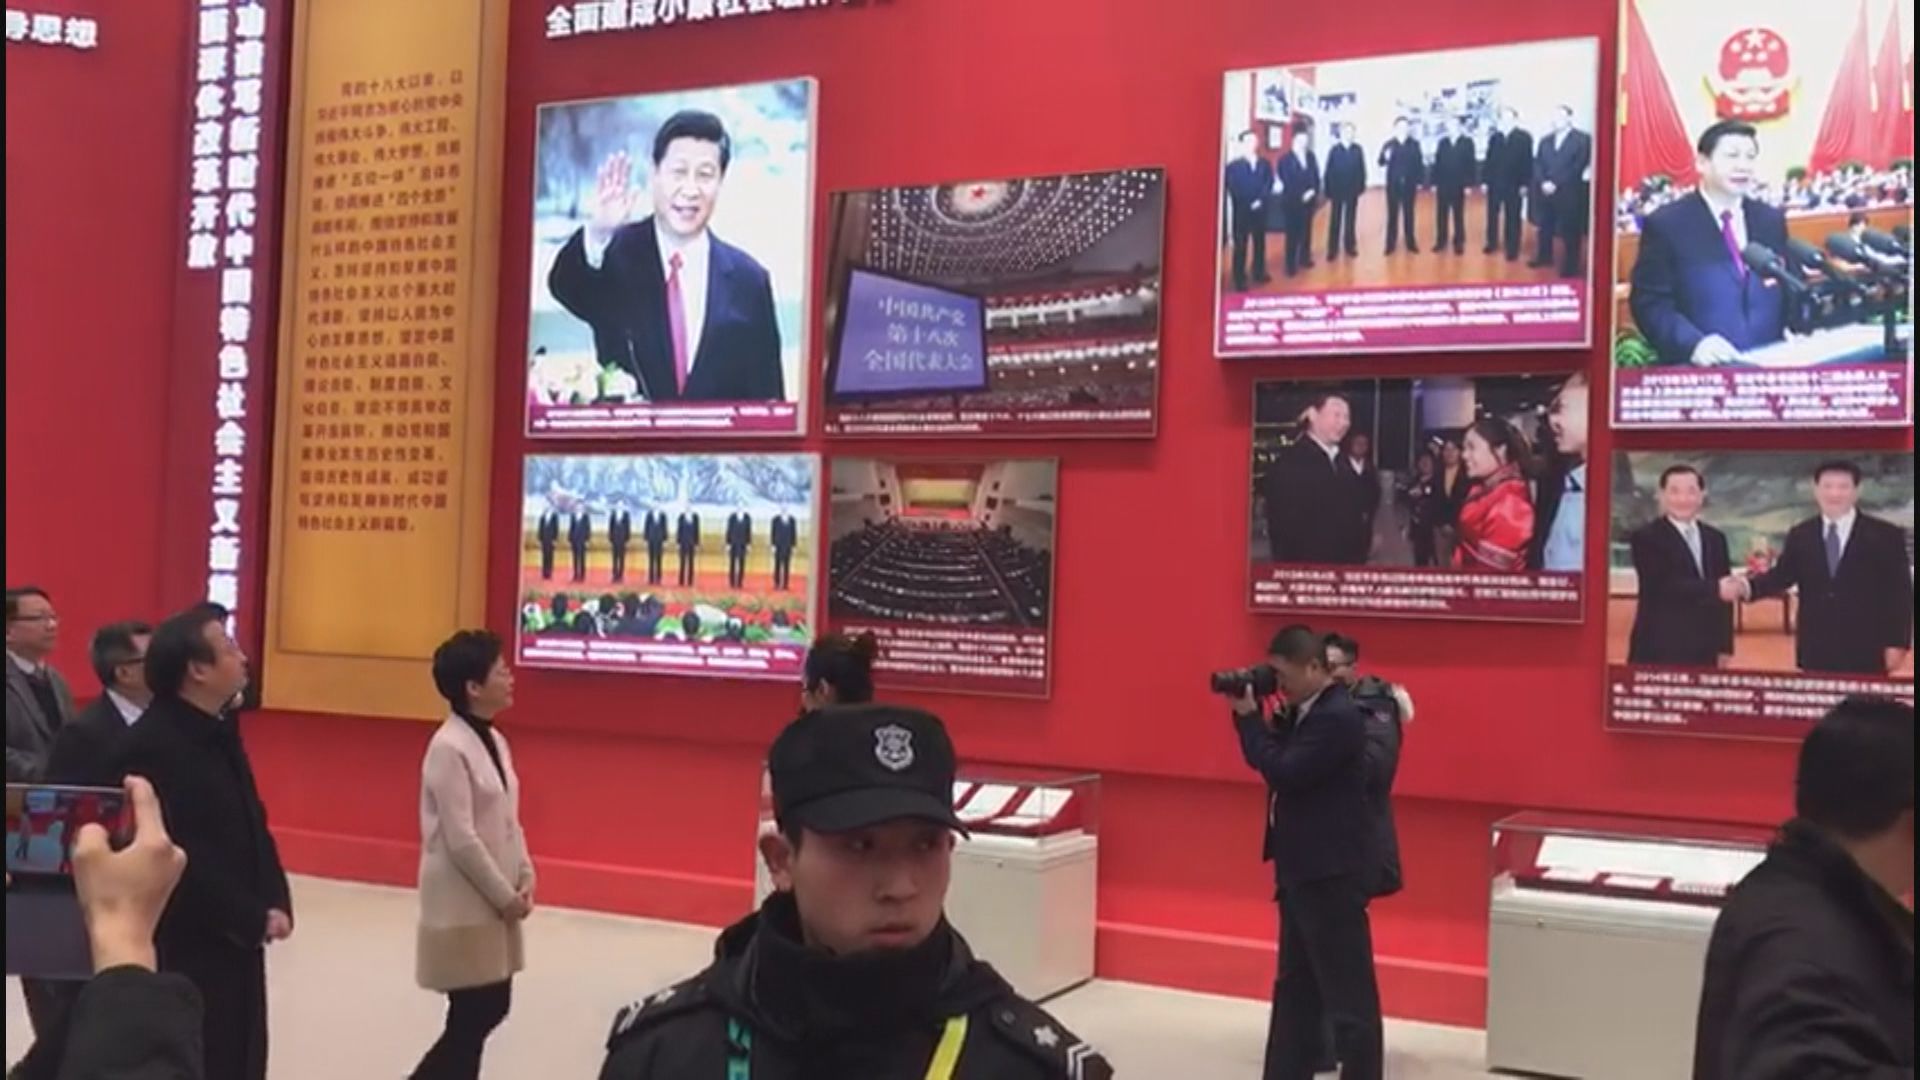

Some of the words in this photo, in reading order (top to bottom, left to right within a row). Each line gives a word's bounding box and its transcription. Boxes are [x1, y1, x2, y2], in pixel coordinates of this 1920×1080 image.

[187, 0, 230, 269] 面深化改革开放
[878, 295, 967, 327] 中国共产党
[887, 323, 961, 347] 第十八次
[864, 348, 974, 371] 全国代表大会
